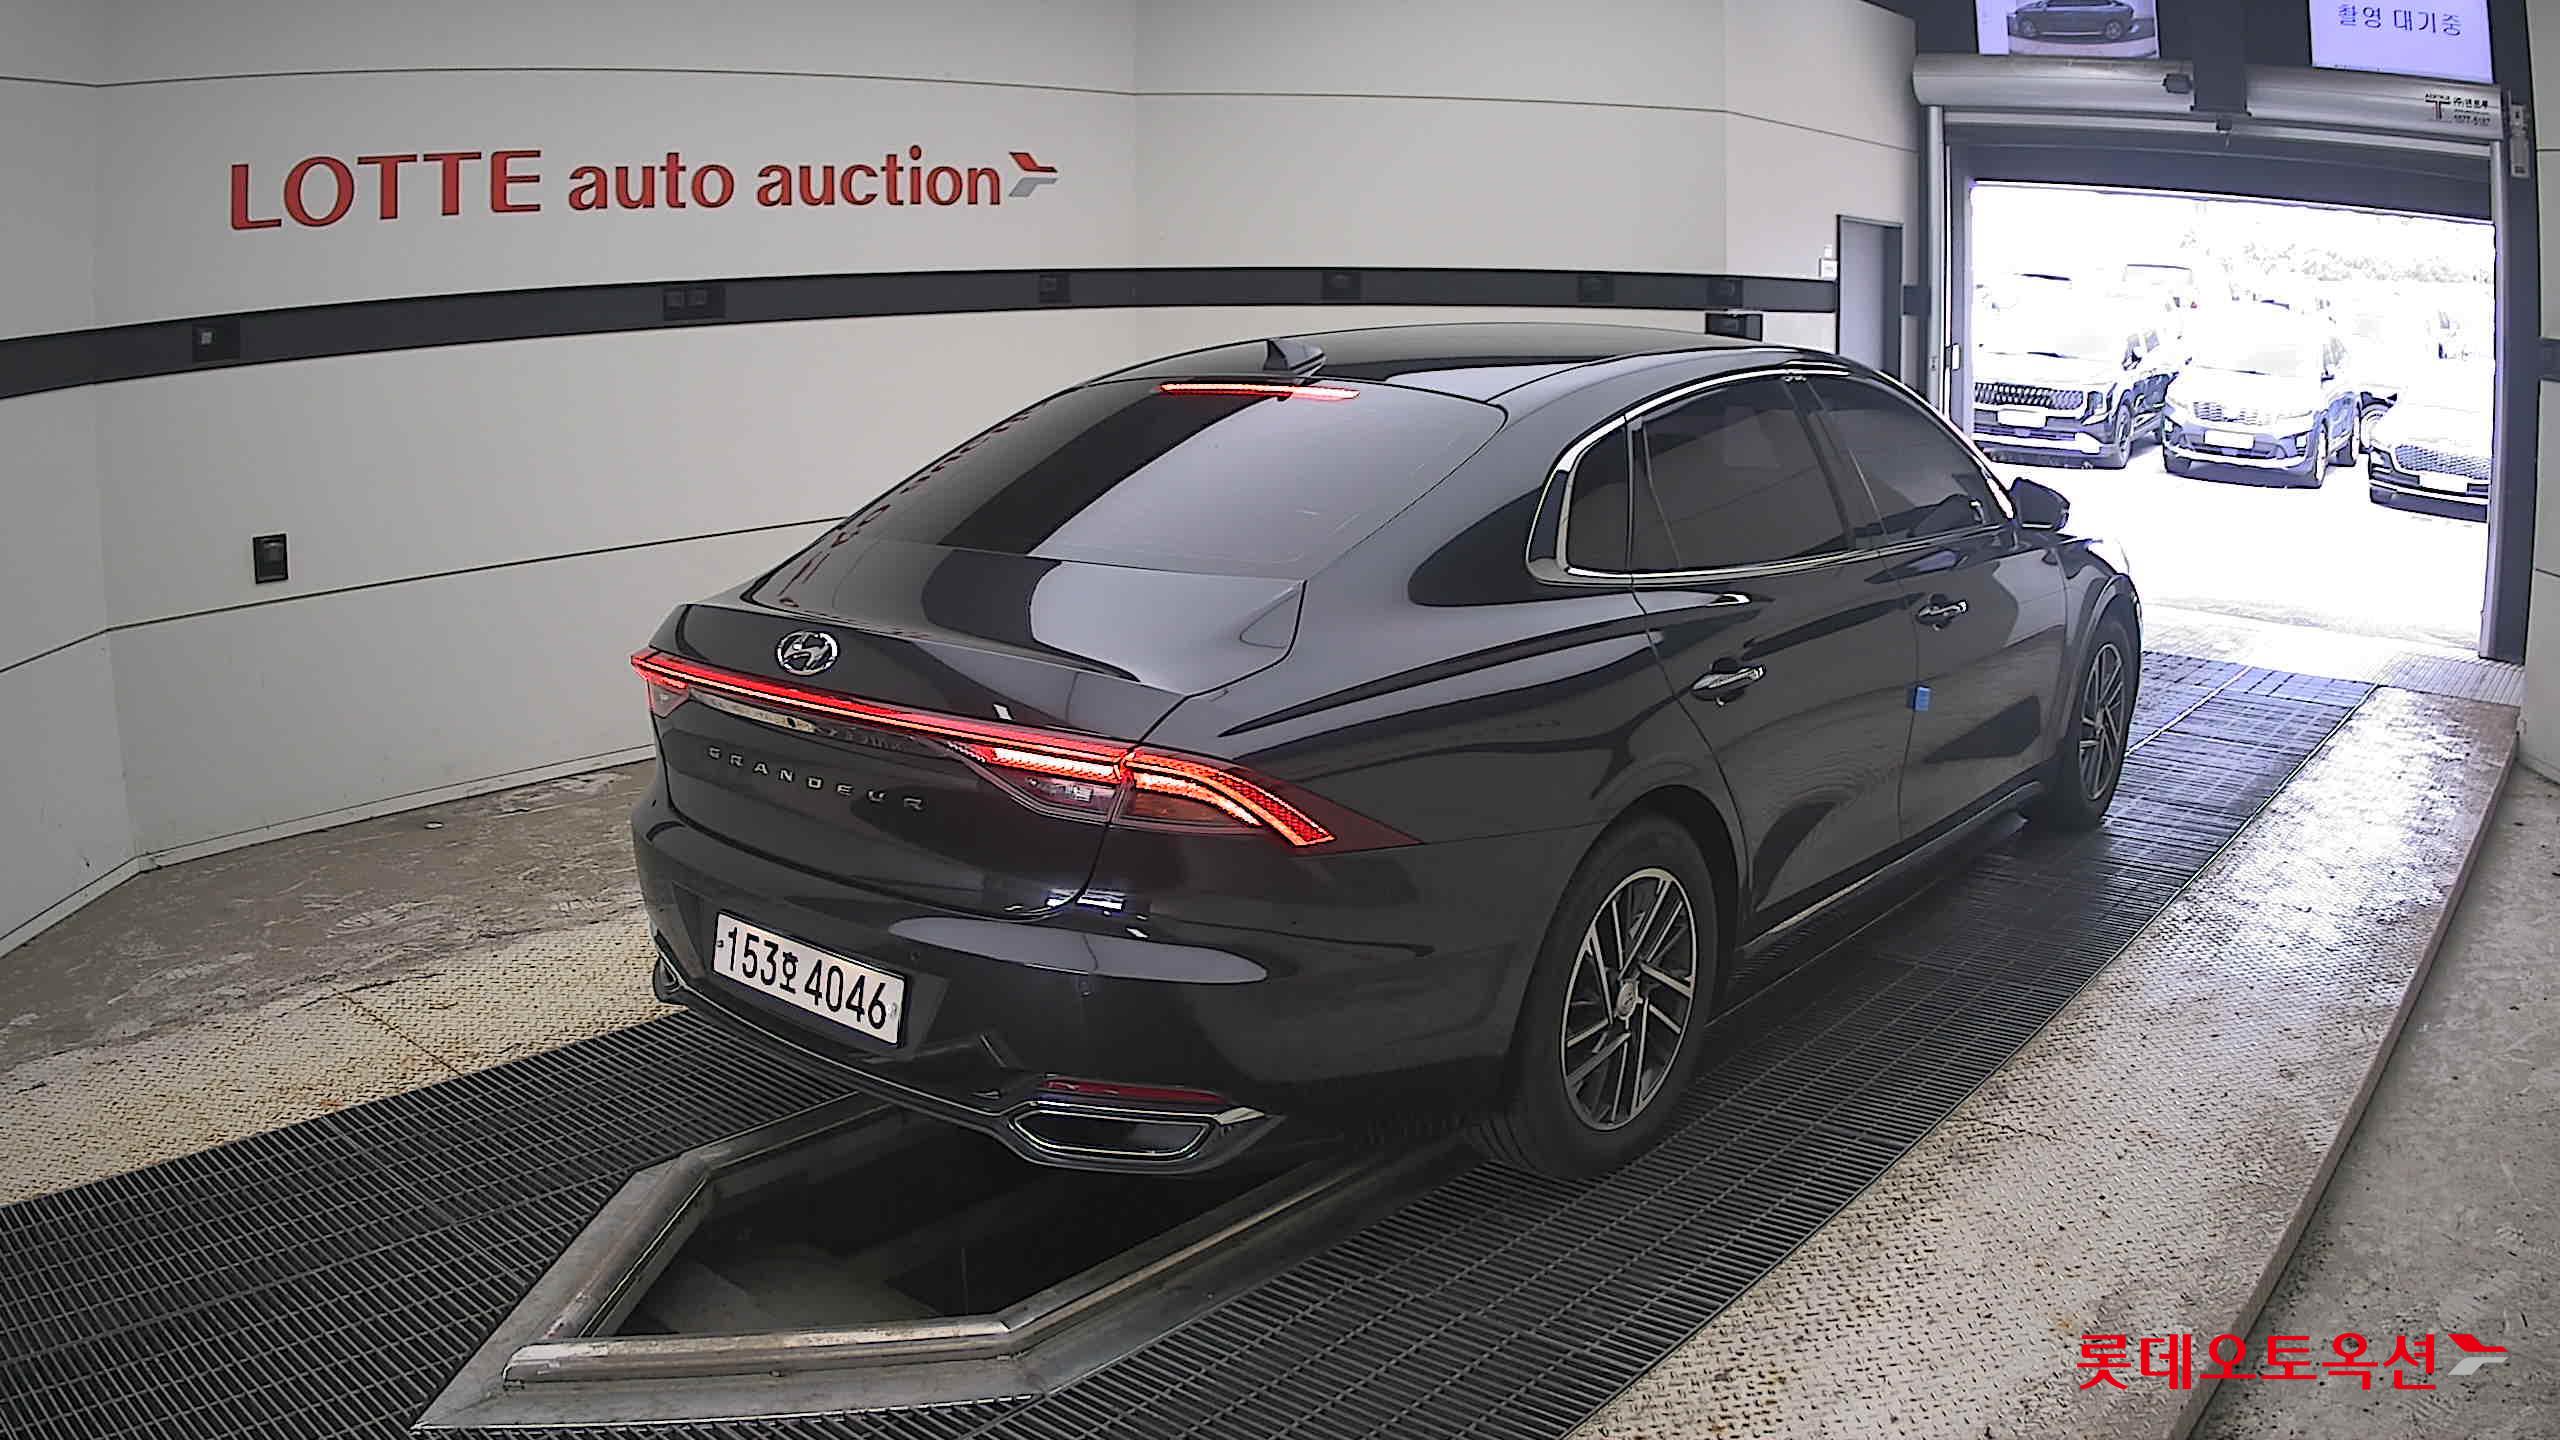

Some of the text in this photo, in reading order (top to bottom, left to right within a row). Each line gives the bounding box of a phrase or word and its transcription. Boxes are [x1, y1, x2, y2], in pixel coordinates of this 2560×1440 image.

[2337, 4, 2462, 36] 촬영 대기중
[229, 145, 1002, 231] LOTTE auto auction
[708, 746, 924, 811] GRANDEUR
